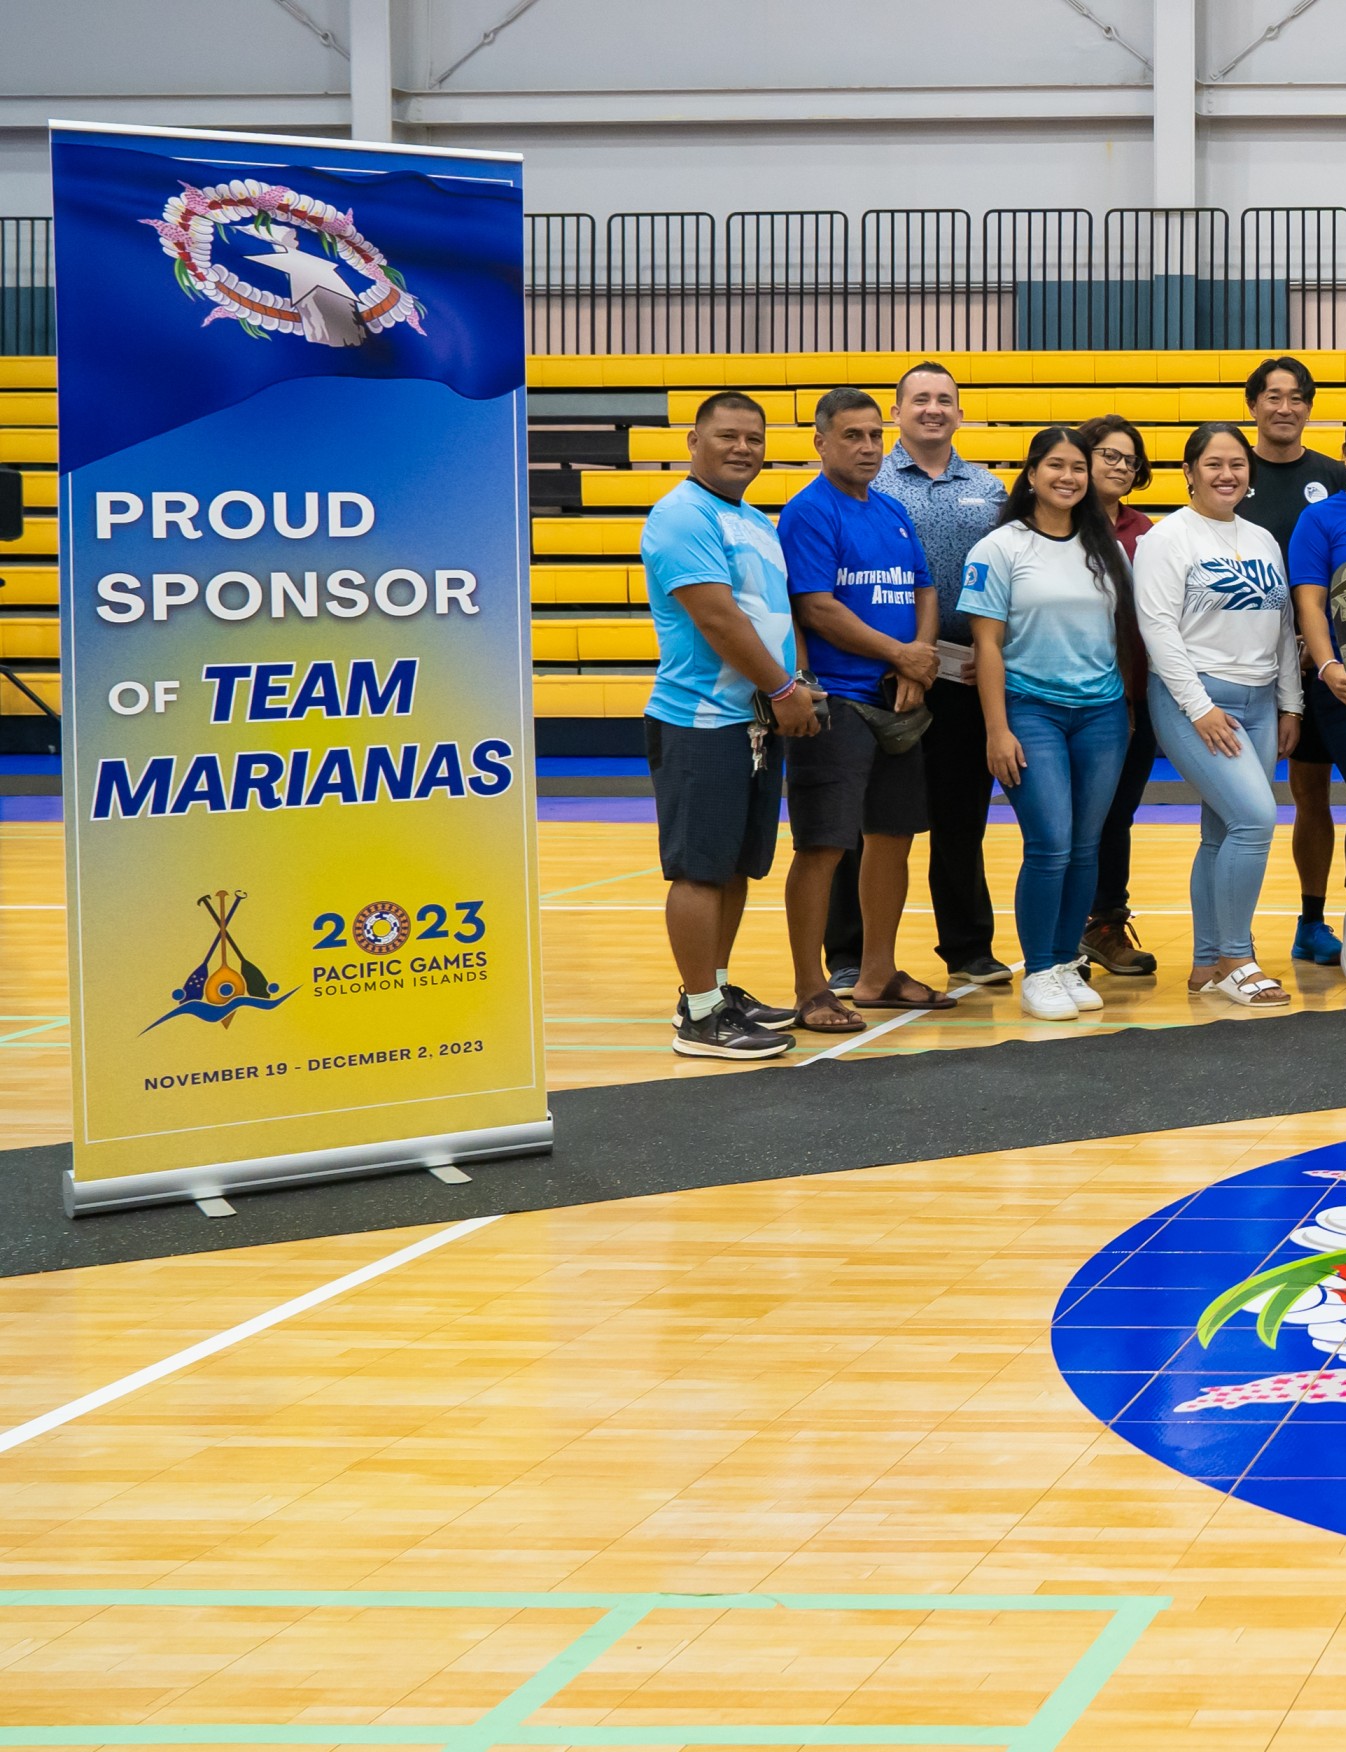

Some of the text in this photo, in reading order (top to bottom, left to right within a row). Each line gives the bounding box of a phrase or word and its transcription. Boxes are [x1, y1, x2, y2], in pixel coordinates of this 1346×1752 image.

[96, 490, 375, 540] PROUD
[96, 569, 480, 623] SPONSOR
[108, 657, 419, 724] OF TEAM
[90, 739, 514, 821] MARIANAS
[312, 951, 488, 983] PACIFIC GAMES
[313, 970, 488, 998] SOLOMON ISLANDS
[144, 1064, 260, 1091] NOVEMBER
[266, 1061, 287, 1077] 19
[307, 1048, 412, 1072] DECEMBER
[418, 1047, 433, 1061] 2,
[438, 1040, 484, 1056] 2023
